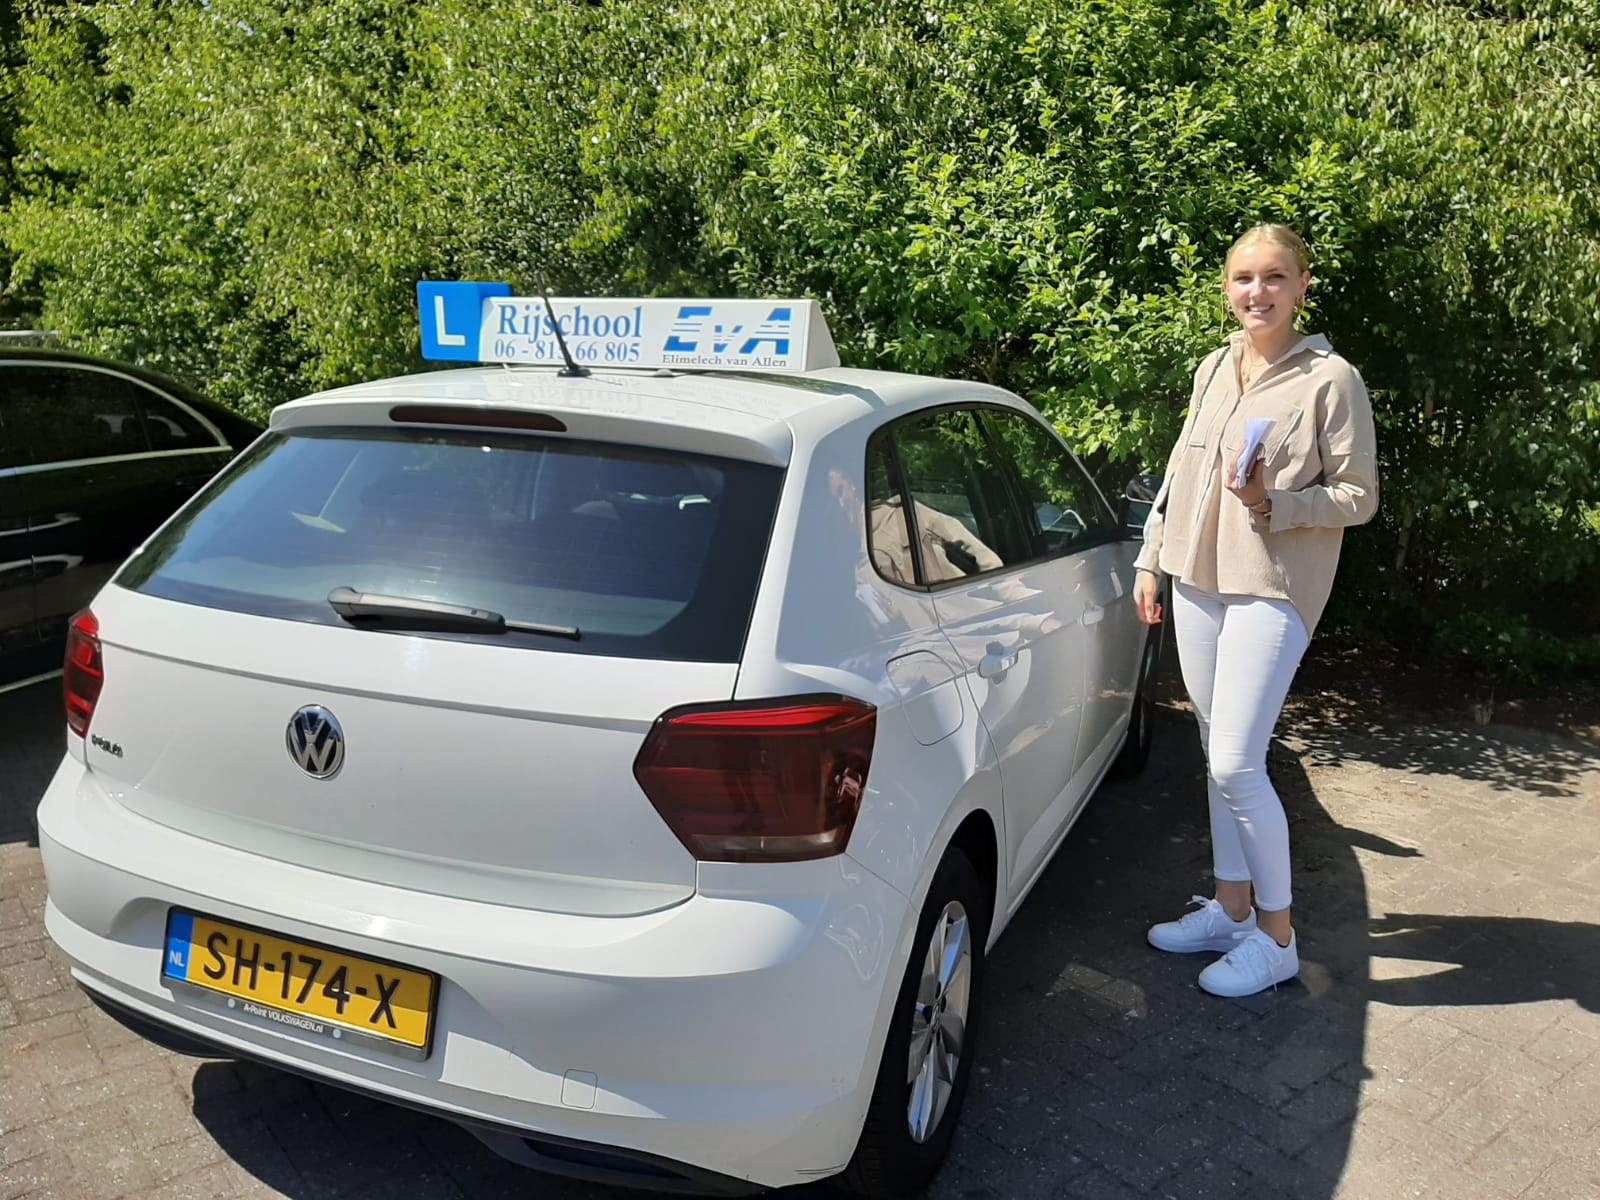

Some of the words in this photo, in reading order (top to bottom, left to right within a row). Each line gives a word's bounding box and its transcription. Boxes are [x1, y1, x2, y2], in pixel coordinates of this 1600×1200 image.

[434, 296, 465, 345] L
[497, 304, 642, 343] Rijschool
[495, 339, 515, 358] 06
[576, 341, 598, 361] 66
[605, 342, 640, 362] 805
[662, 354, 721, 364] Elimelech
[726, 357, 748, 366] van
[752, 357, 787, 367] Allen
[169, 950, 185, 967] NL
[204, 932, 400, 1029] SH-174-X
[244, 1003, 268, 1017] A-Point
[268, 1010, 324, 1033] VOLKSWAGEN.nl
